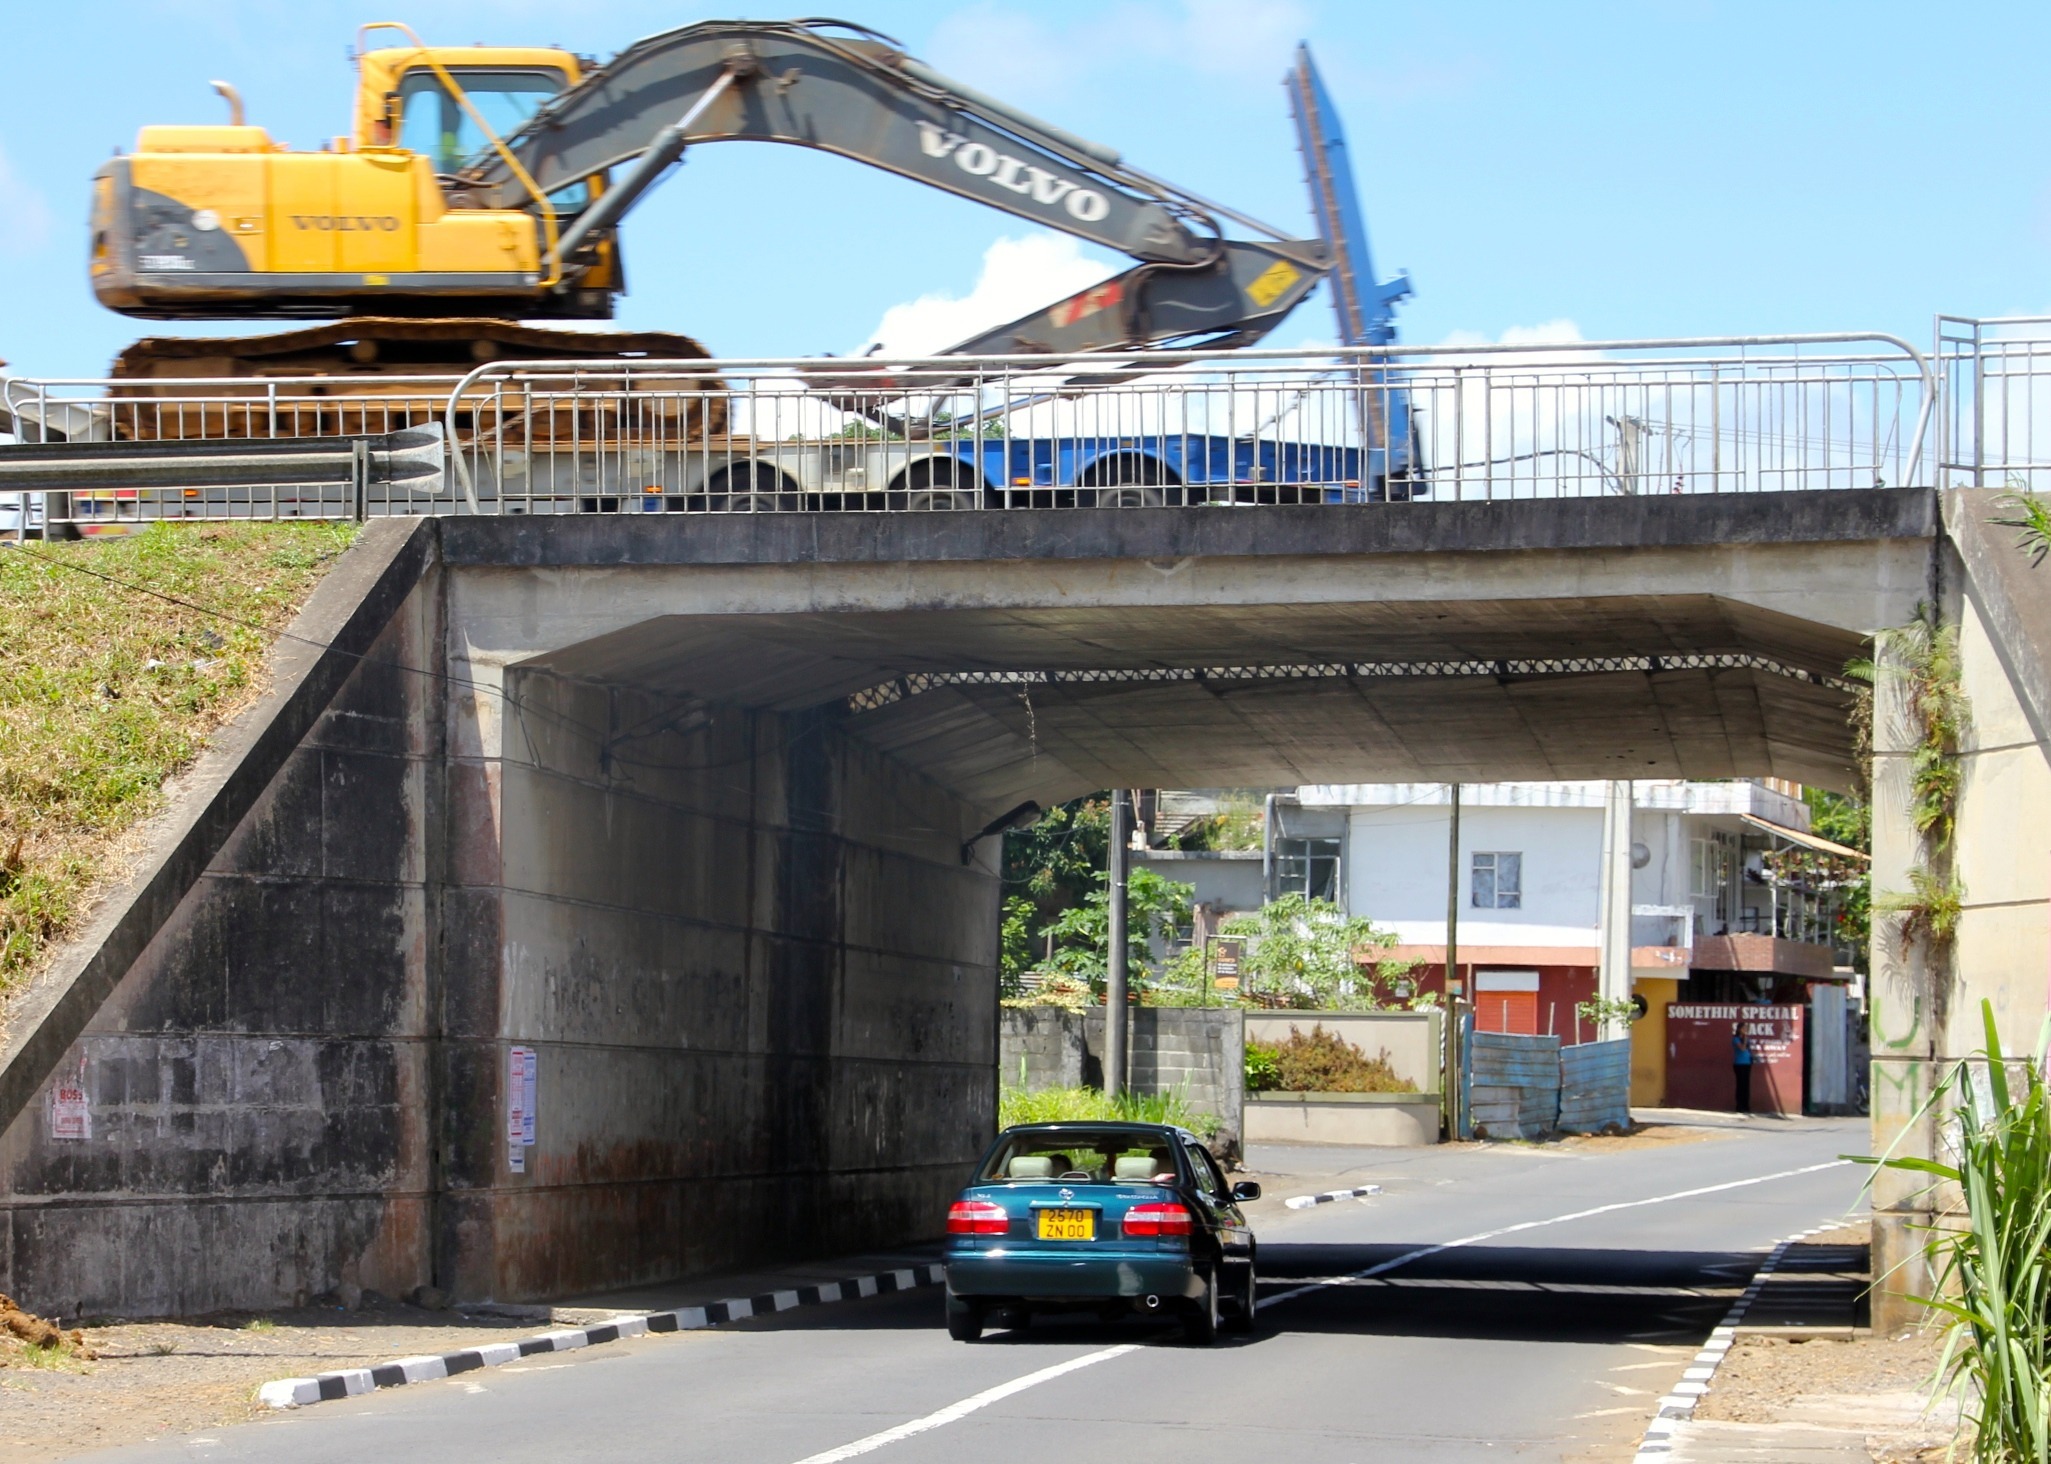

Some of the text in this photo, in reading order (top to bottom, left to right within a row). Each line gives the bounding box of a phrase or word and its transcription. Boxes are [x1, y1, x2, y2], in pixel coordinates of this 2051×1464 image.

[914, 119, 1110, 221] VOLVO
[289, 215, 399, 231] VOLVO
[1741, 1006, 1798, 1020] SPECIAL
[1732, 1022, 1774, 1036] SACK
[1048, 1209, 1084, 1222] 2570
[1046, 1224, 1064, 1238] ZN
